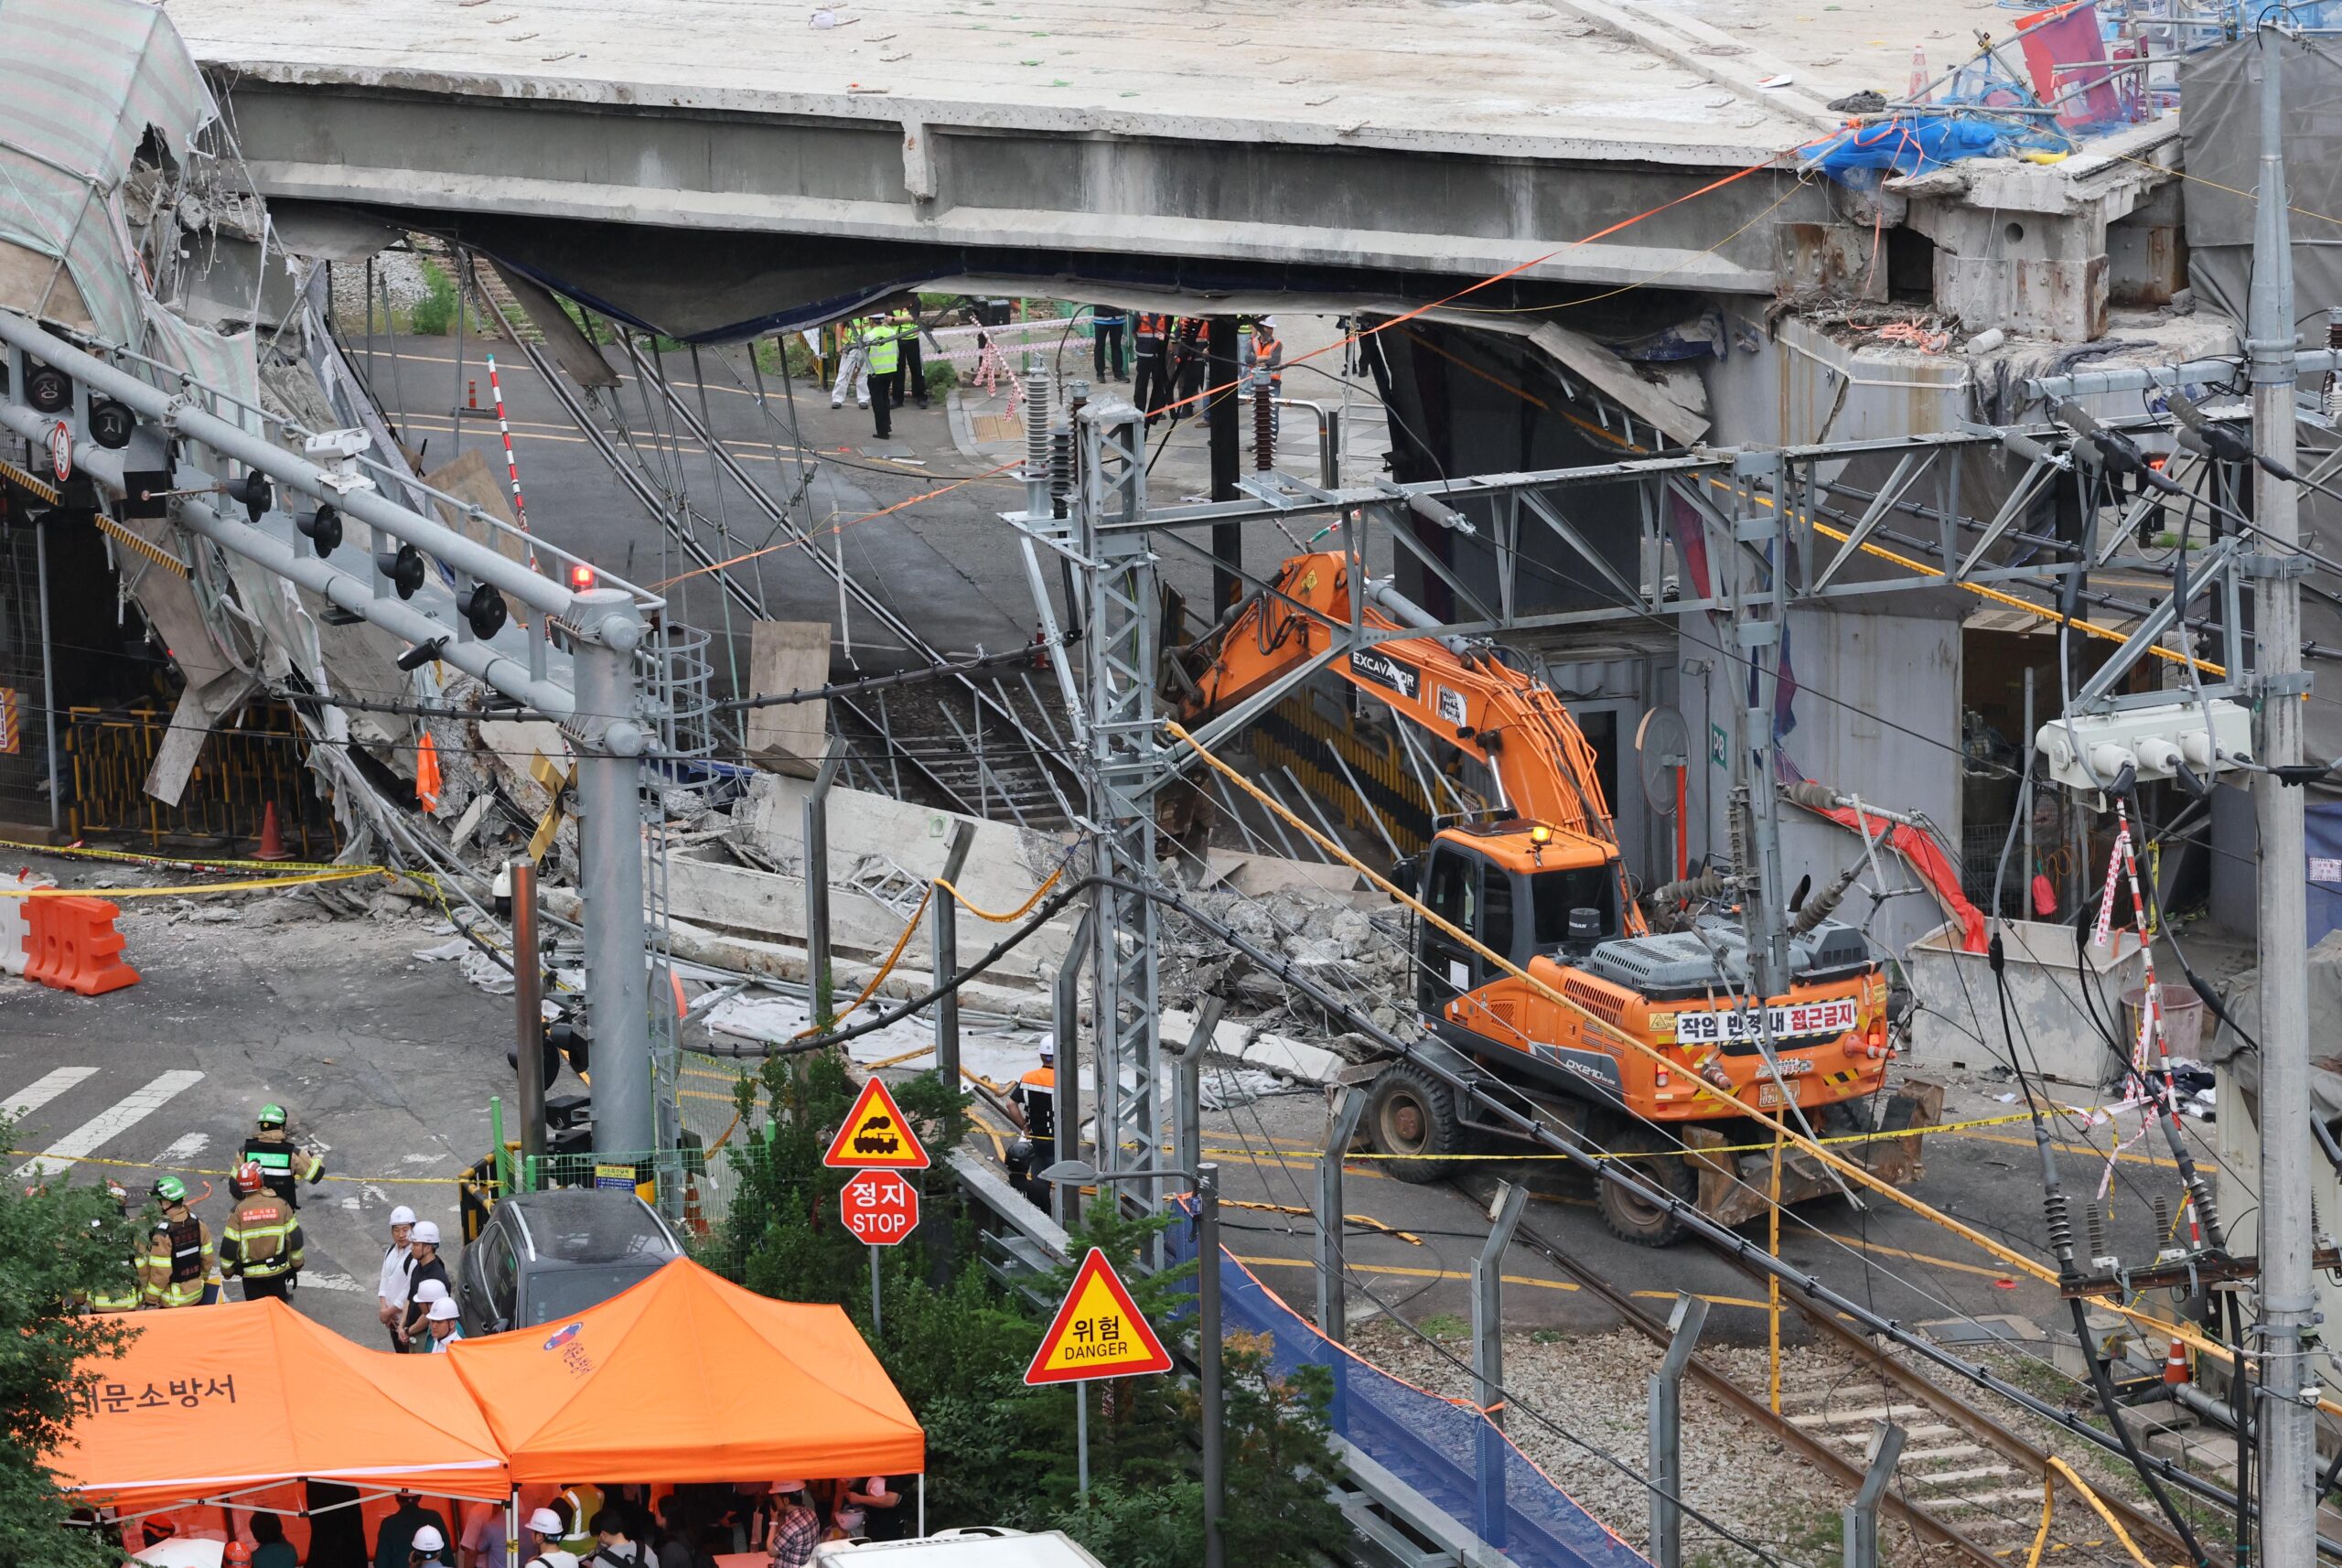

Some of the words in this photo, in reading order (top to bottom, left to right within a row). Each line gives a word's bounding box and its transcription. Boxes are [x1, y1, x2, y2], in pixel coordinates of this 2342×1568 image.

[1713, 731, 1724, 762] P8
[1681, 1016, 1718, 1038] 작업
[1727, 1014, 1762, 1036] 반경
[1768, 1011, 1784, 1033] 내
[1790, 1004, 1853, 1031] 접근금지
[852, 1181, 906, 1208] 정지
[853, 1213, 906, 1233] STOP
[1072, 1315, 1120, 1343] 위험
[1064, 1341, 1128, 1360] DANGER
